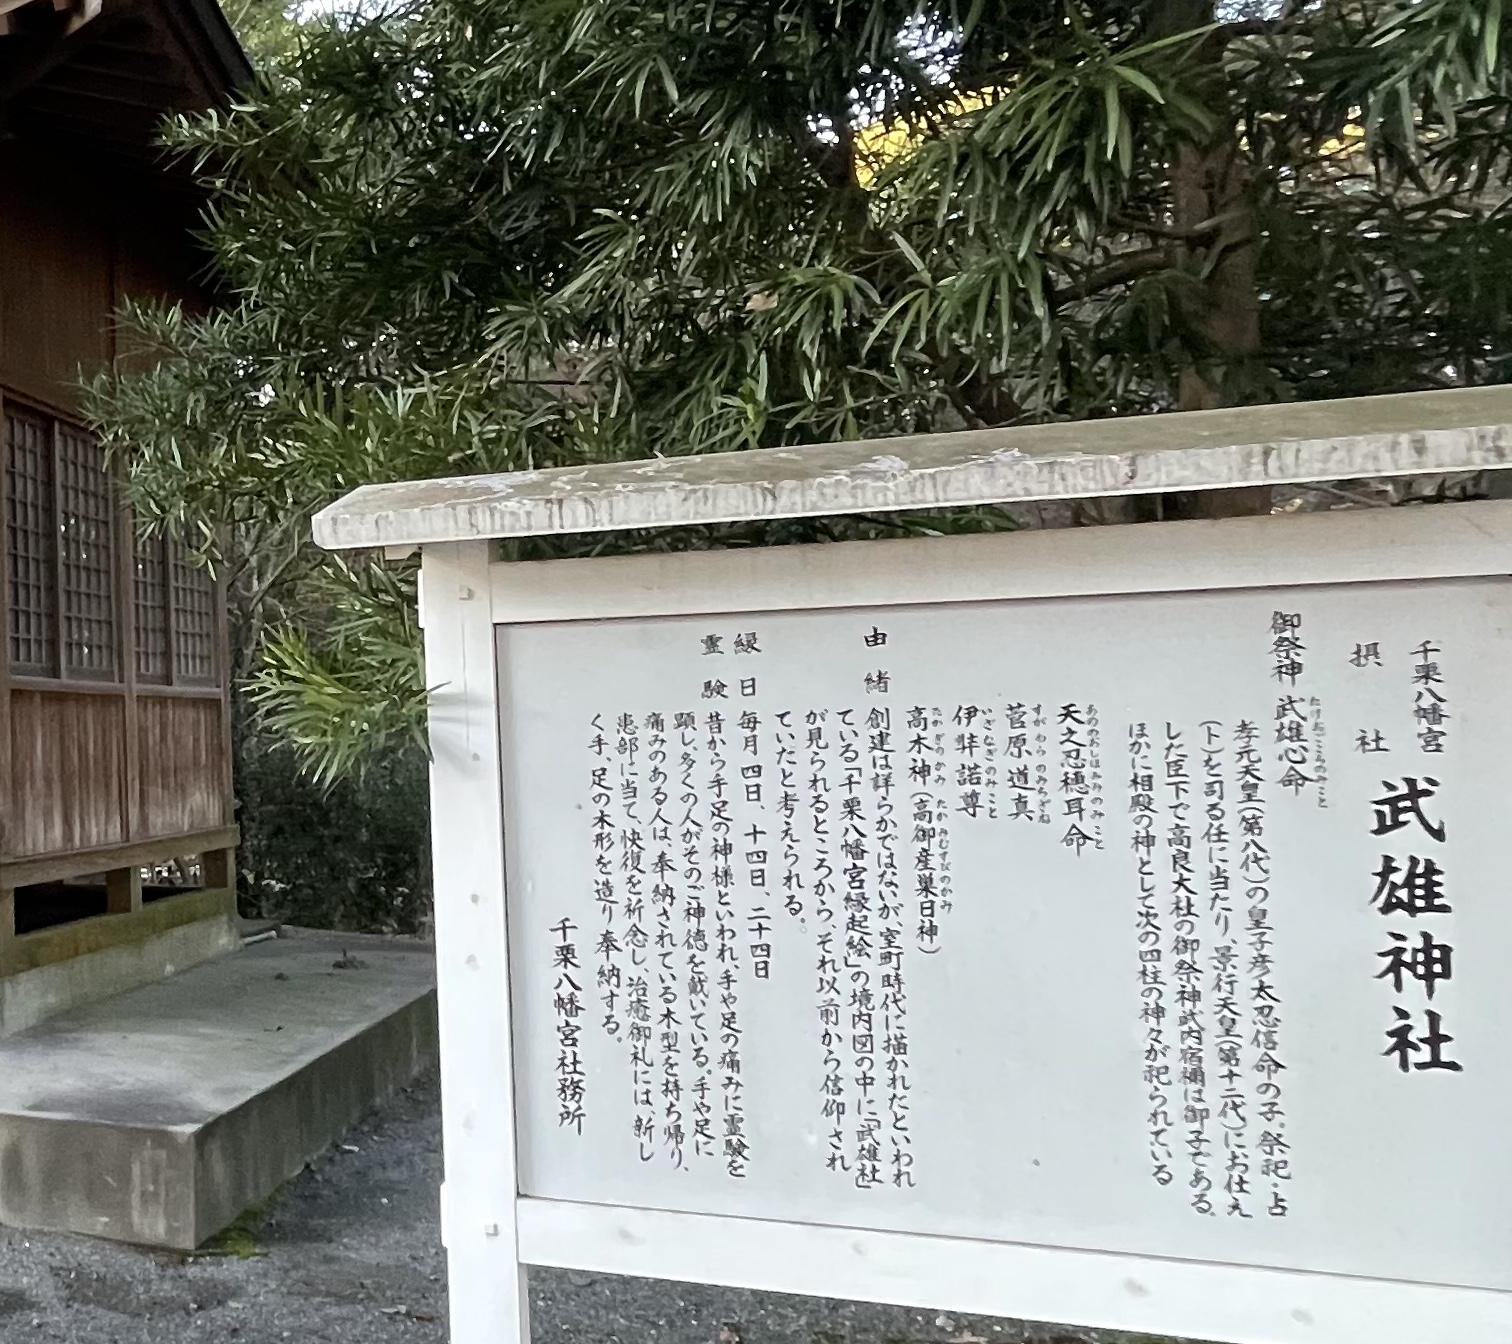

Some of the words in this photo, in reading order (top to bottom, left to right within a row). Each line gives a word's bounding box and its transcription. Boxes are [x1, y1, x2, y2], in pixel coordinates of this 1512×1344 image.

[733, 631, 763, 697] 縁日
[864, 625, 892, 695] 由緒
[1267, 609, 1308, 688] 御祭神
[1408, 639, 1451, 754] 千栗八幡宮
[1003, 702, 1037, 821] 菅原道真
[1056, 702, 1095, 858] 天之忍穂耳命
[1274, 694, 1318, 797] 武雄心命
[775, 710, 807, 924] ていたと考えられる。
[1368, 774, 1464, 1074] 武雄神社
[548, 916, 587, 1137] 千栗八幡宮社務所
